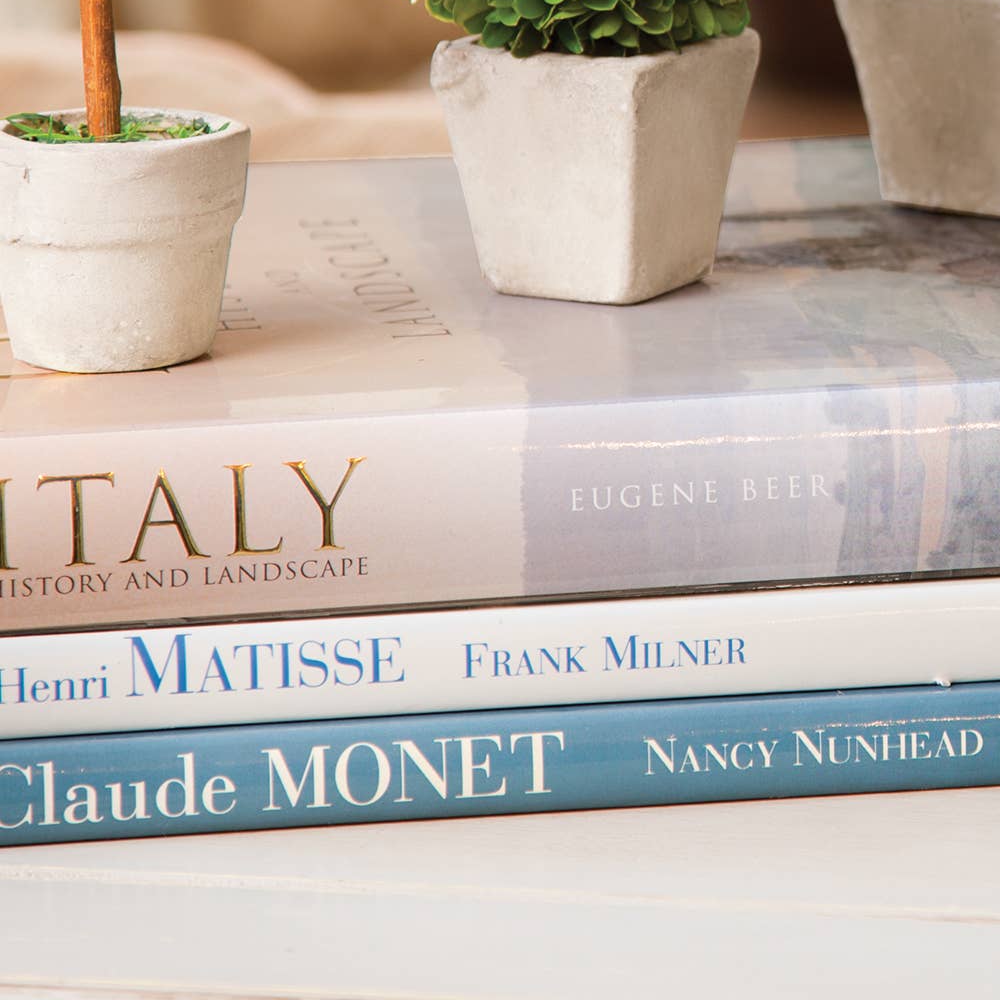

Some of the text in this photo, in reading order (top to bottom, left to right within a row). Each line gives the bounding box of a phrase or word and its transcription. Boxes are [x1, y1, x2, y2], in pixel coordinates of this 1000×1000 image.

[571, 473, 830, 511] EUGENE BEER
[124, 567, 190, 591] AND
[204, 556, 369, 585] LANDSCAPE
[0, 633, 747, 704] Henri MATISSE FRANK MILNER
[0, 729, 985, 829] Claude MONET NANCY NUNHEAD
